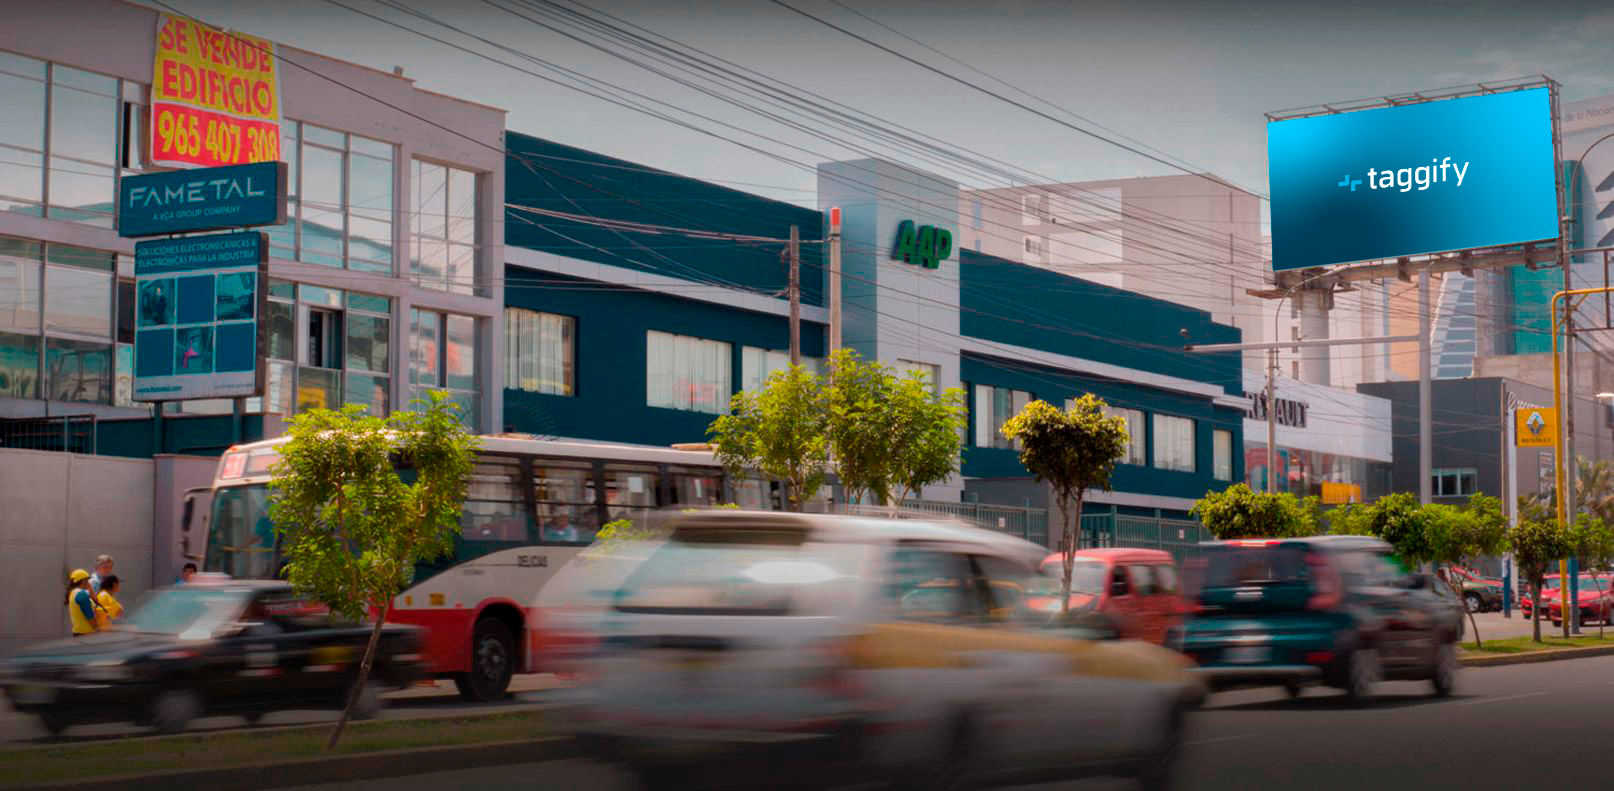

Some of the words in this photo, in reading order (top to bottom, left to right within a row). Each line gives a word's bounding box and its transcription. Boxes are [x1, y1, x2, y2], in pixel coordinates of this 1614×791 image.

[161, 16, 188, 54] SE
[194, 23, 272, 72] VENDE
[162, 59, 273, 117] EDIFICIO
[158, 111, 200, 157] 965
[205, 120, 240, 164] 407
[248, 127, 278, 163] 308
[129, 177, 266, 208] FAMETAL
[1367, 156, 1469, 192] taggify
[176, 208, 202, 218] GROUP
[203, 205, 240, 216] COMPANY
[137, 245, 179, 257] SOLUCIONES
[892, 219, 952, 269] AAP
